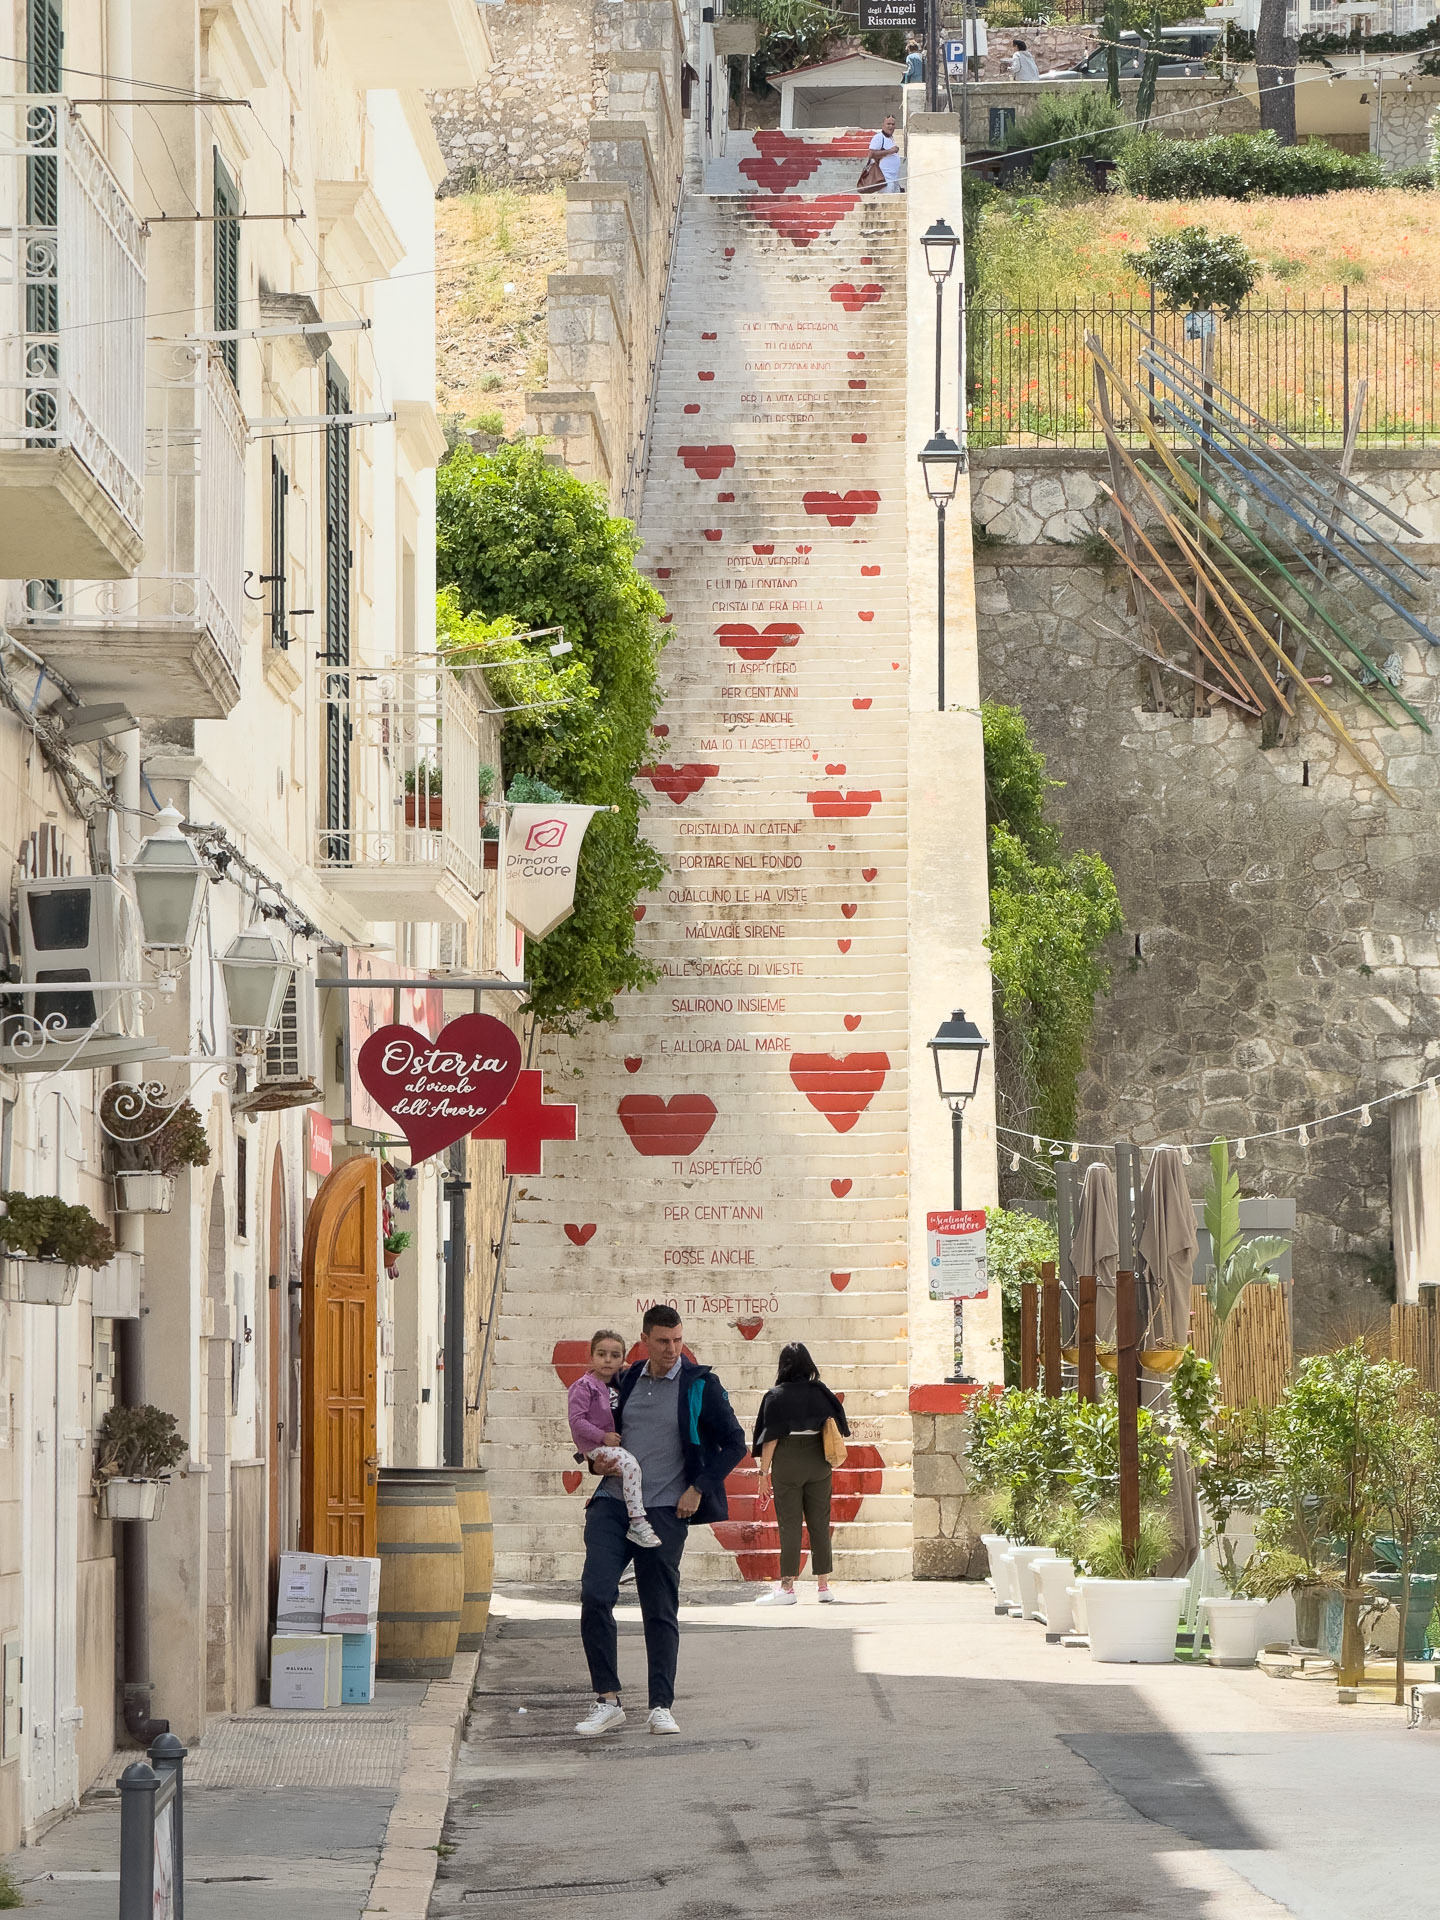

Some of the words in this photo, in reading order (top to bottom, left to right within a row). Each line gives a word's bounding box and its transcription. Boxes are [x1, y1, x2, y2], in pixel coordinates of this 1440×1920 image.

[884, 4, 916, 16] Angeli
[868, 16, 916, 26] Ristorante
[950, 42, 963, 60] P
[740, 394, 758, 403] PER
[776, 394, 794, 402] VITA
[728, 557, 764, 566] POTEVA
[706, 580, 712, 590] E
[716, 579, 731, 590] LUI
[734, 580, 748, 590] DA
[752, 579, 798, 588] LONTANO
[712, 602, 765, 611] CRISTALDA
[728, 663, 736, 673] TI
[722, 687, 741, 698] PER
[724, 712, 755, 724] FOSSE
[760, 712, 794, 724] ANCHE
[700, 739, 718, 750] MA
[722, 739, 732, 750] IO
[738, 739, 747, 750] TI
[680, 823, 740, 835] CRISTALDA
[744, 823, 754, 834] IN
[760, 823, 803, 834] CATENE
[506, 854, 558, 866] Dimora
[680, 856, 730, 868] PORTARE
[735, 856, 756, 868] NEL
[762, 856, 802, 868] FONDO
[522, 866, 571, 878] Cuore
[668, 888, 732, 904] QUALCUNO
[736, 888, 750, 902] LE
[754, 888, 770, 902] HA
[776, 887, 808, 902] VISTE
[685, 925, 740, 938] MALVAGIE
[744, 925, 786, 938] SIRENE
[662, 963, 691, 976] ALLE
[696, 963, 743, 976] SPIAGGE
[748, 963, 760, 976] DI
[765, 962, 804, 976] VIESTE
[672, 998, 733, 1012] SALIRONO
[738, 998, 786, 1012] INSIEME
[660, 1040, 668, 1054] E
[674, 1040, 721, 1053] ALLORA
[726, 1038, 750, 1052] DAL
[756, 1038, 792, 1052] MARE
[382, 1040, 508, 1076] Osteria
[404, 1075, 427, 1094] al
[426, 1076, 477, 1094] vicolo
[392, 1097, 488, 1118] dell'Amore
[672, 1162, 682, 1176] TI
[664, 1206, 689, 1221] PER
[694, 1206, 763, 1220] CENT'ANNI
[936, 1214, 972, 1224] Scalinata
[664, 1250, 704, 1264] FOSSE
[710, 1250, 756, 1264] ANCHE
[684, 1299, 696, 1314] TI
